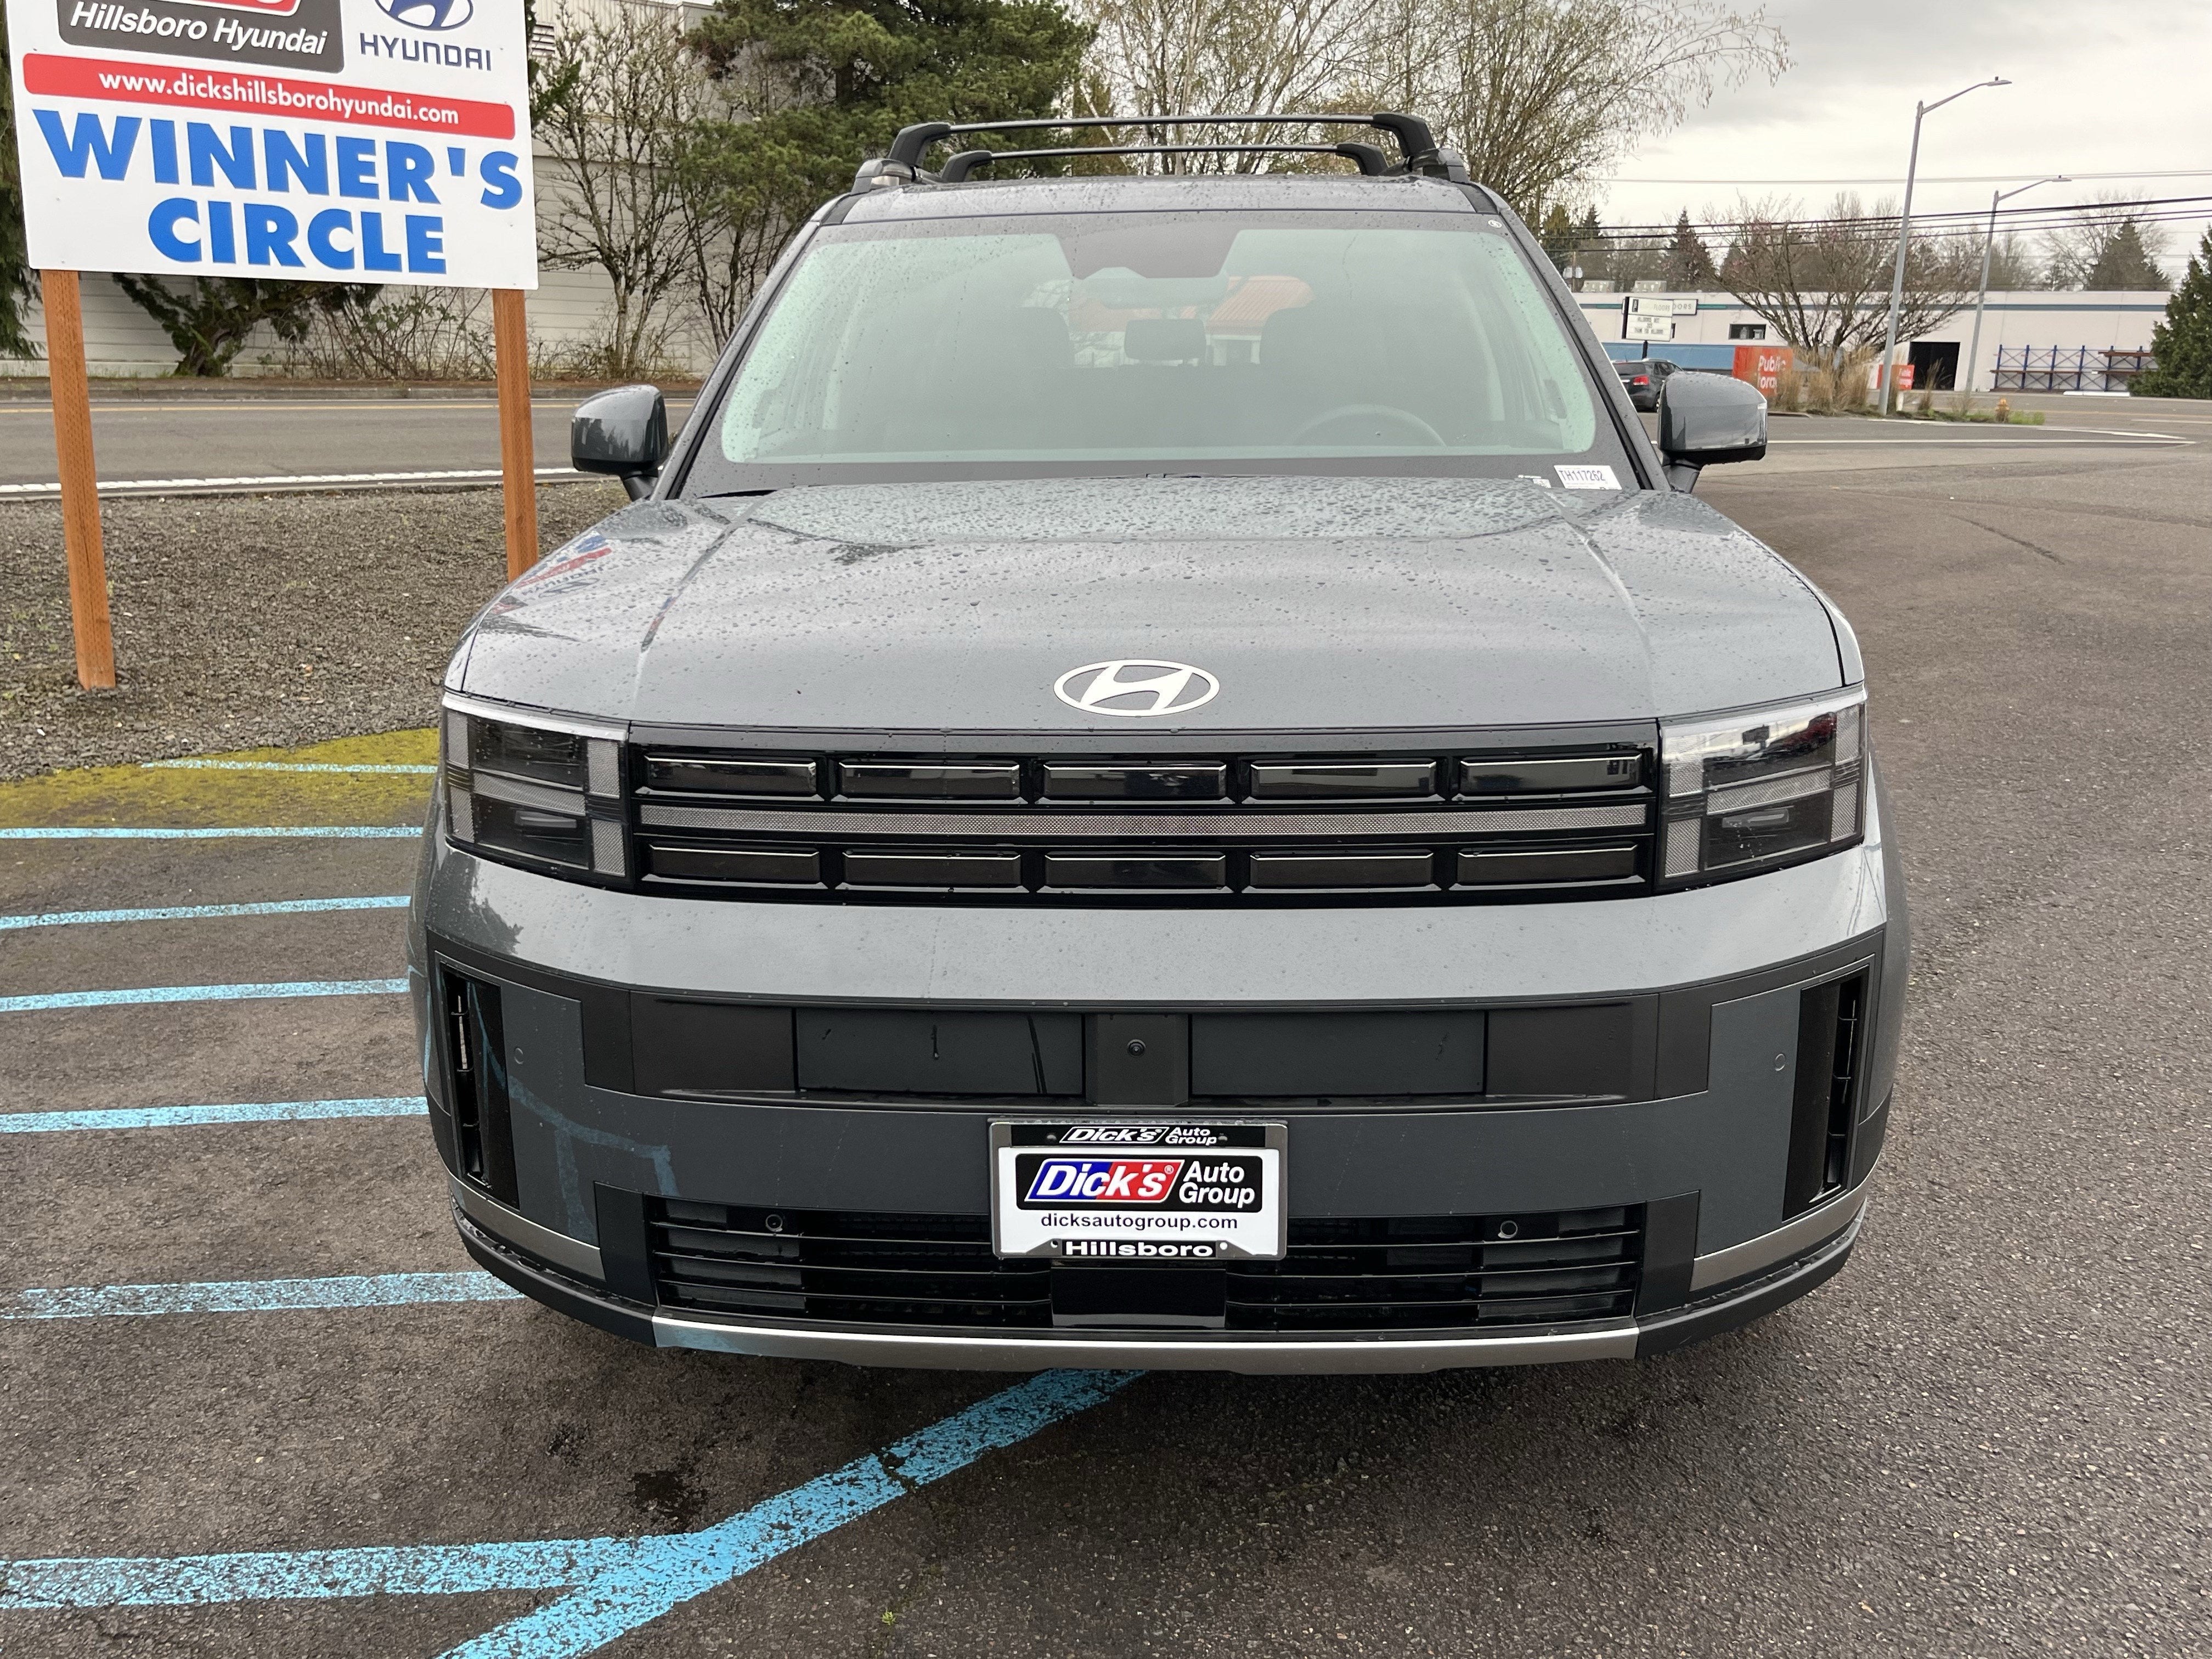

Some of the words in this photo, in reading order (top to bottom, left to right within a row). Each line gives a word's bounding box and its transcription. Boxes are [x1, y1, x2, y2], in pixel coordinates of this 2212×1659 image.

[70, 1, 208, 40] Hillsboro
[213, 18, 329, 54] Hyundai
[359, 32, 492, 71] HYUNDAI
[98, 72, 459, 125] www.dickshillsborohyundai.com
[32, 109, 522, 210] WINNER'S
[148, 197, 447, 274] CIRCLE
[1559, 470, 1606, 481] TH117262
[1165, 1136, 1217, 1146] Group
[1169, 1127, 1211, 1136] Auto
[1183, 1161, 1244, 1183] Auto
[1179, 1182, 1255, 1209] Group
[1041, 1213, 1238, 1231] dicksautogroup.com
[1066, 1241, 1213, 1257] Hillsboro
